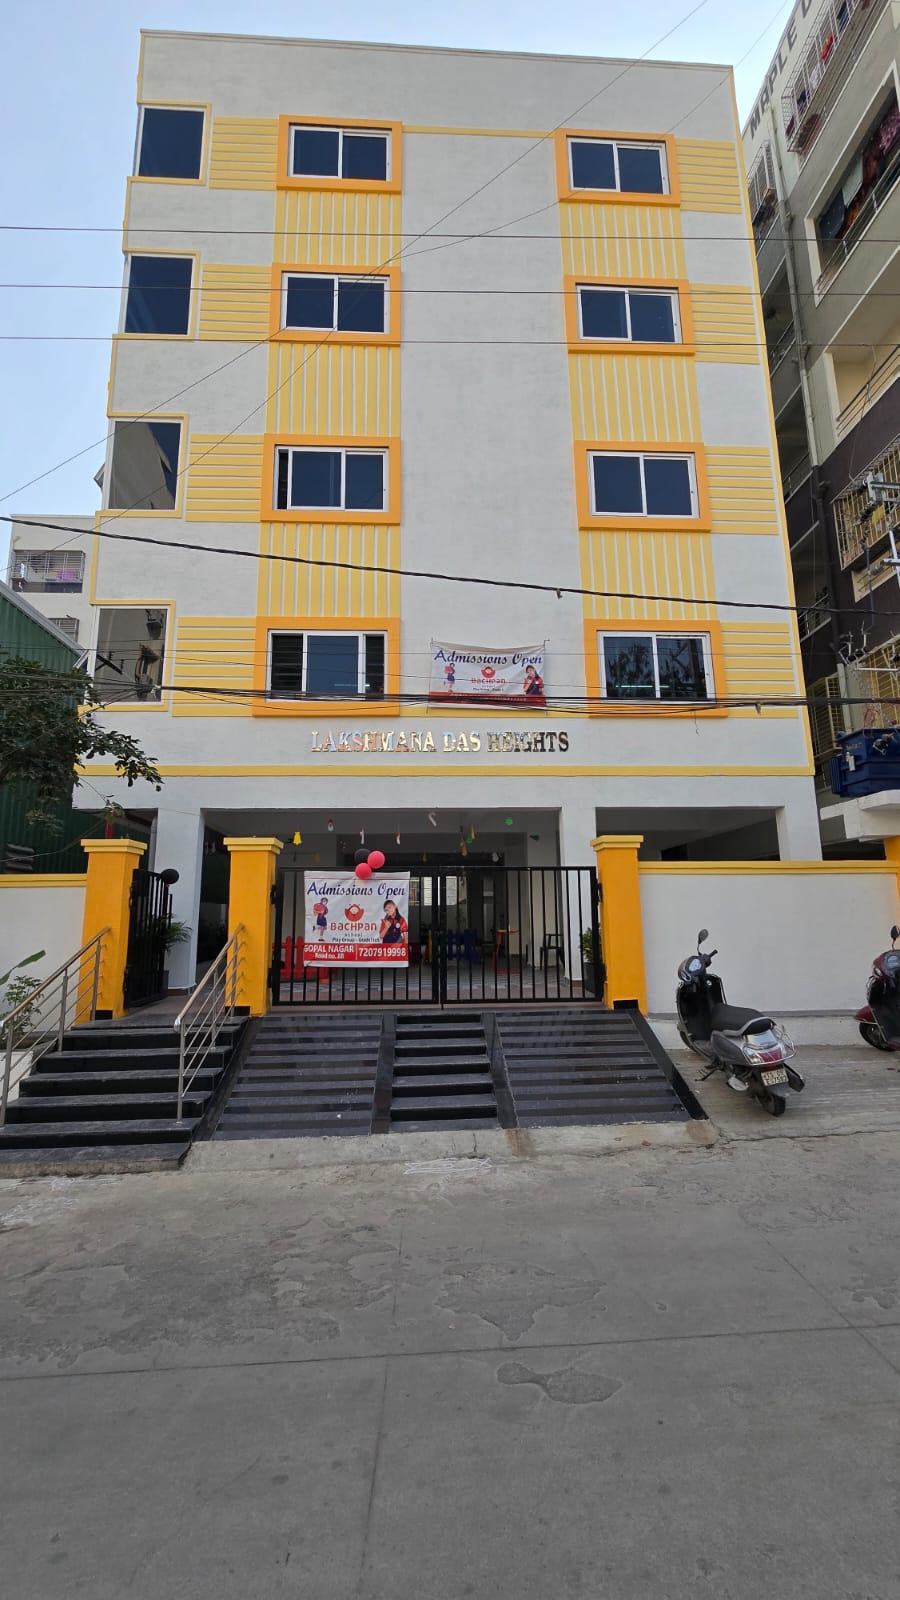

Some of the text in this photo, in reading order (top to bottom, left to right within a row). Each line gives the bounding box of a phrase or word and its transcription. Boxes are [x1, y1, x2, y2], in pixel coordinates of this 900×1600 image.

[749, 21, 798, 139] MAPLE
[434, 650, 542, 667] Admissions Open
[311, 731, 569, 752] LAKSHMANA DAS HEIGHTS
[307, 882, 406, 898] Admissions Open
[304, 944, 354, 952] GOPAL NAGAR
[359, 948, 406, 957] 7207919998
